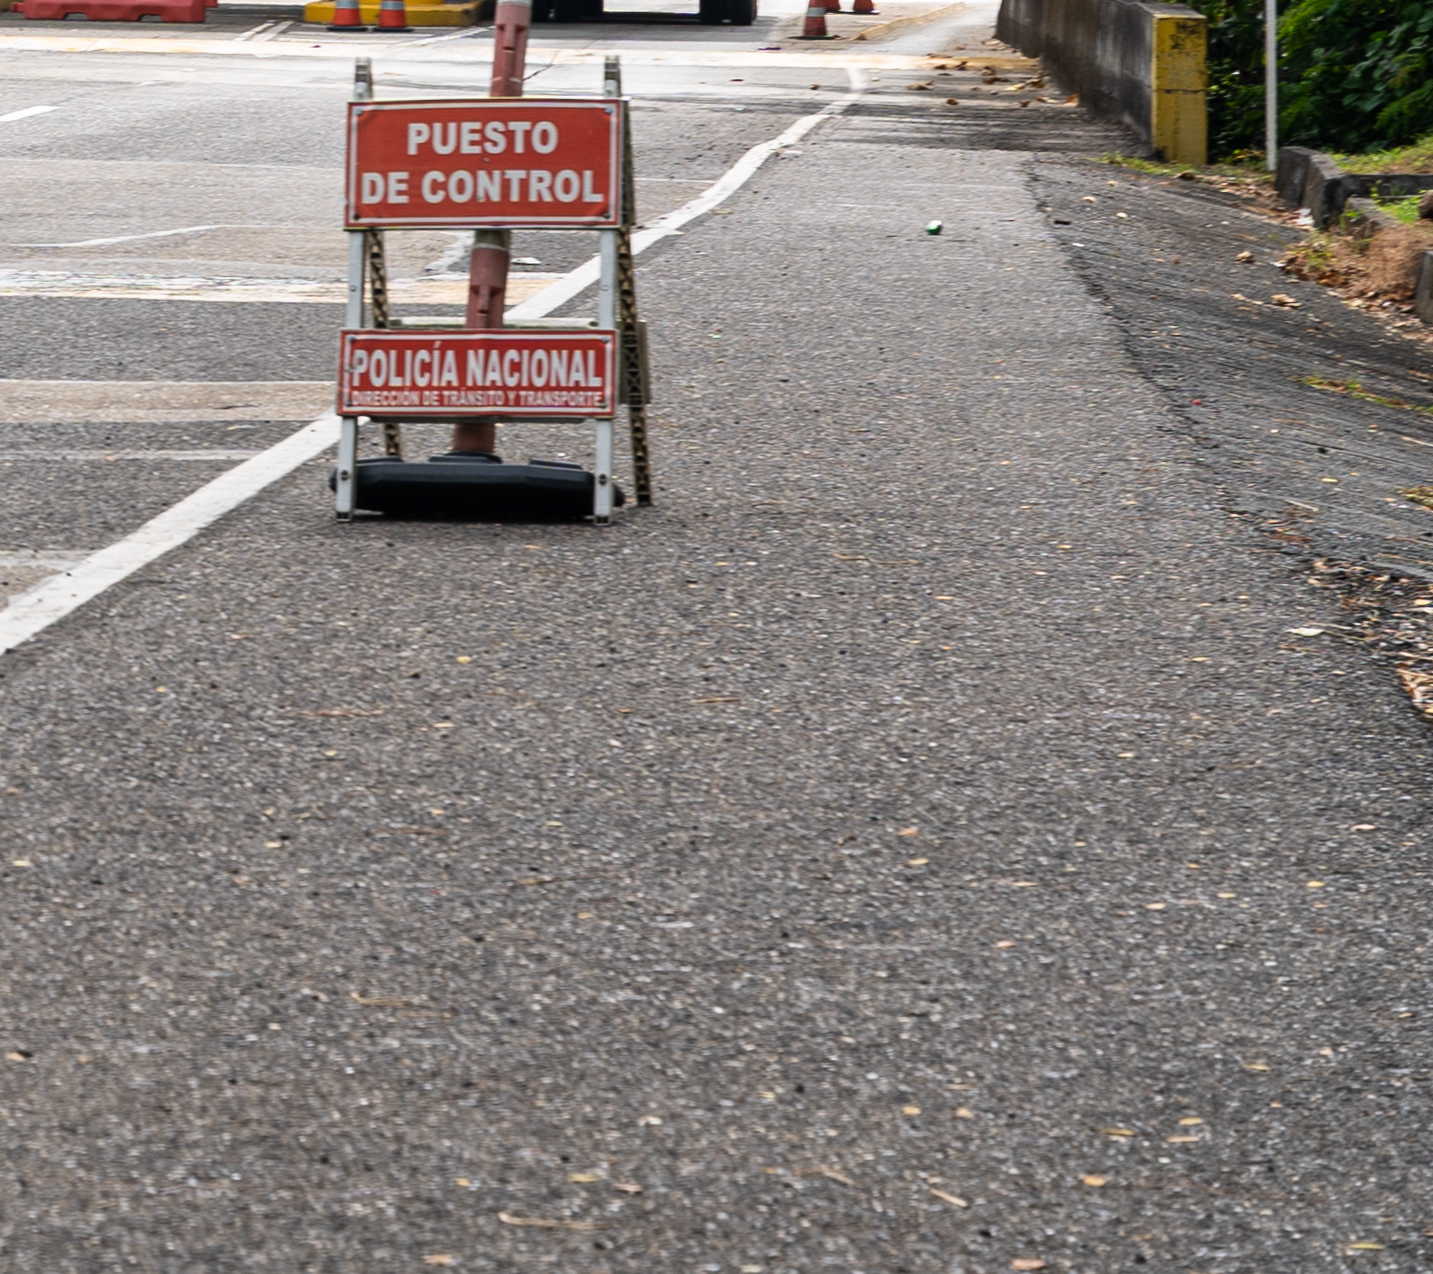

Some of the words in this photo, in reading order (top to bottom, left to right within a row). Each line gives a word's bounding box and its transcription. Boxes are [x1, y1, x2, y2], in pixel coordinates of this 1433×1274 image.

[407, 120, 559, 156] PUESTO
[361, 170, 409, 205] DE
[421, 169, 604, 204] CONTROL
[351, 341, 460, 388] POLICÍA
[465, 348, 603, 388] NACIONAL
[351, 388, 420, 407] DIRECCIÓN
[422, 390, 440, 406] DE
[506, 390, 516, 406] Y
[518, 390, 603, 407] TRANSPORTE
